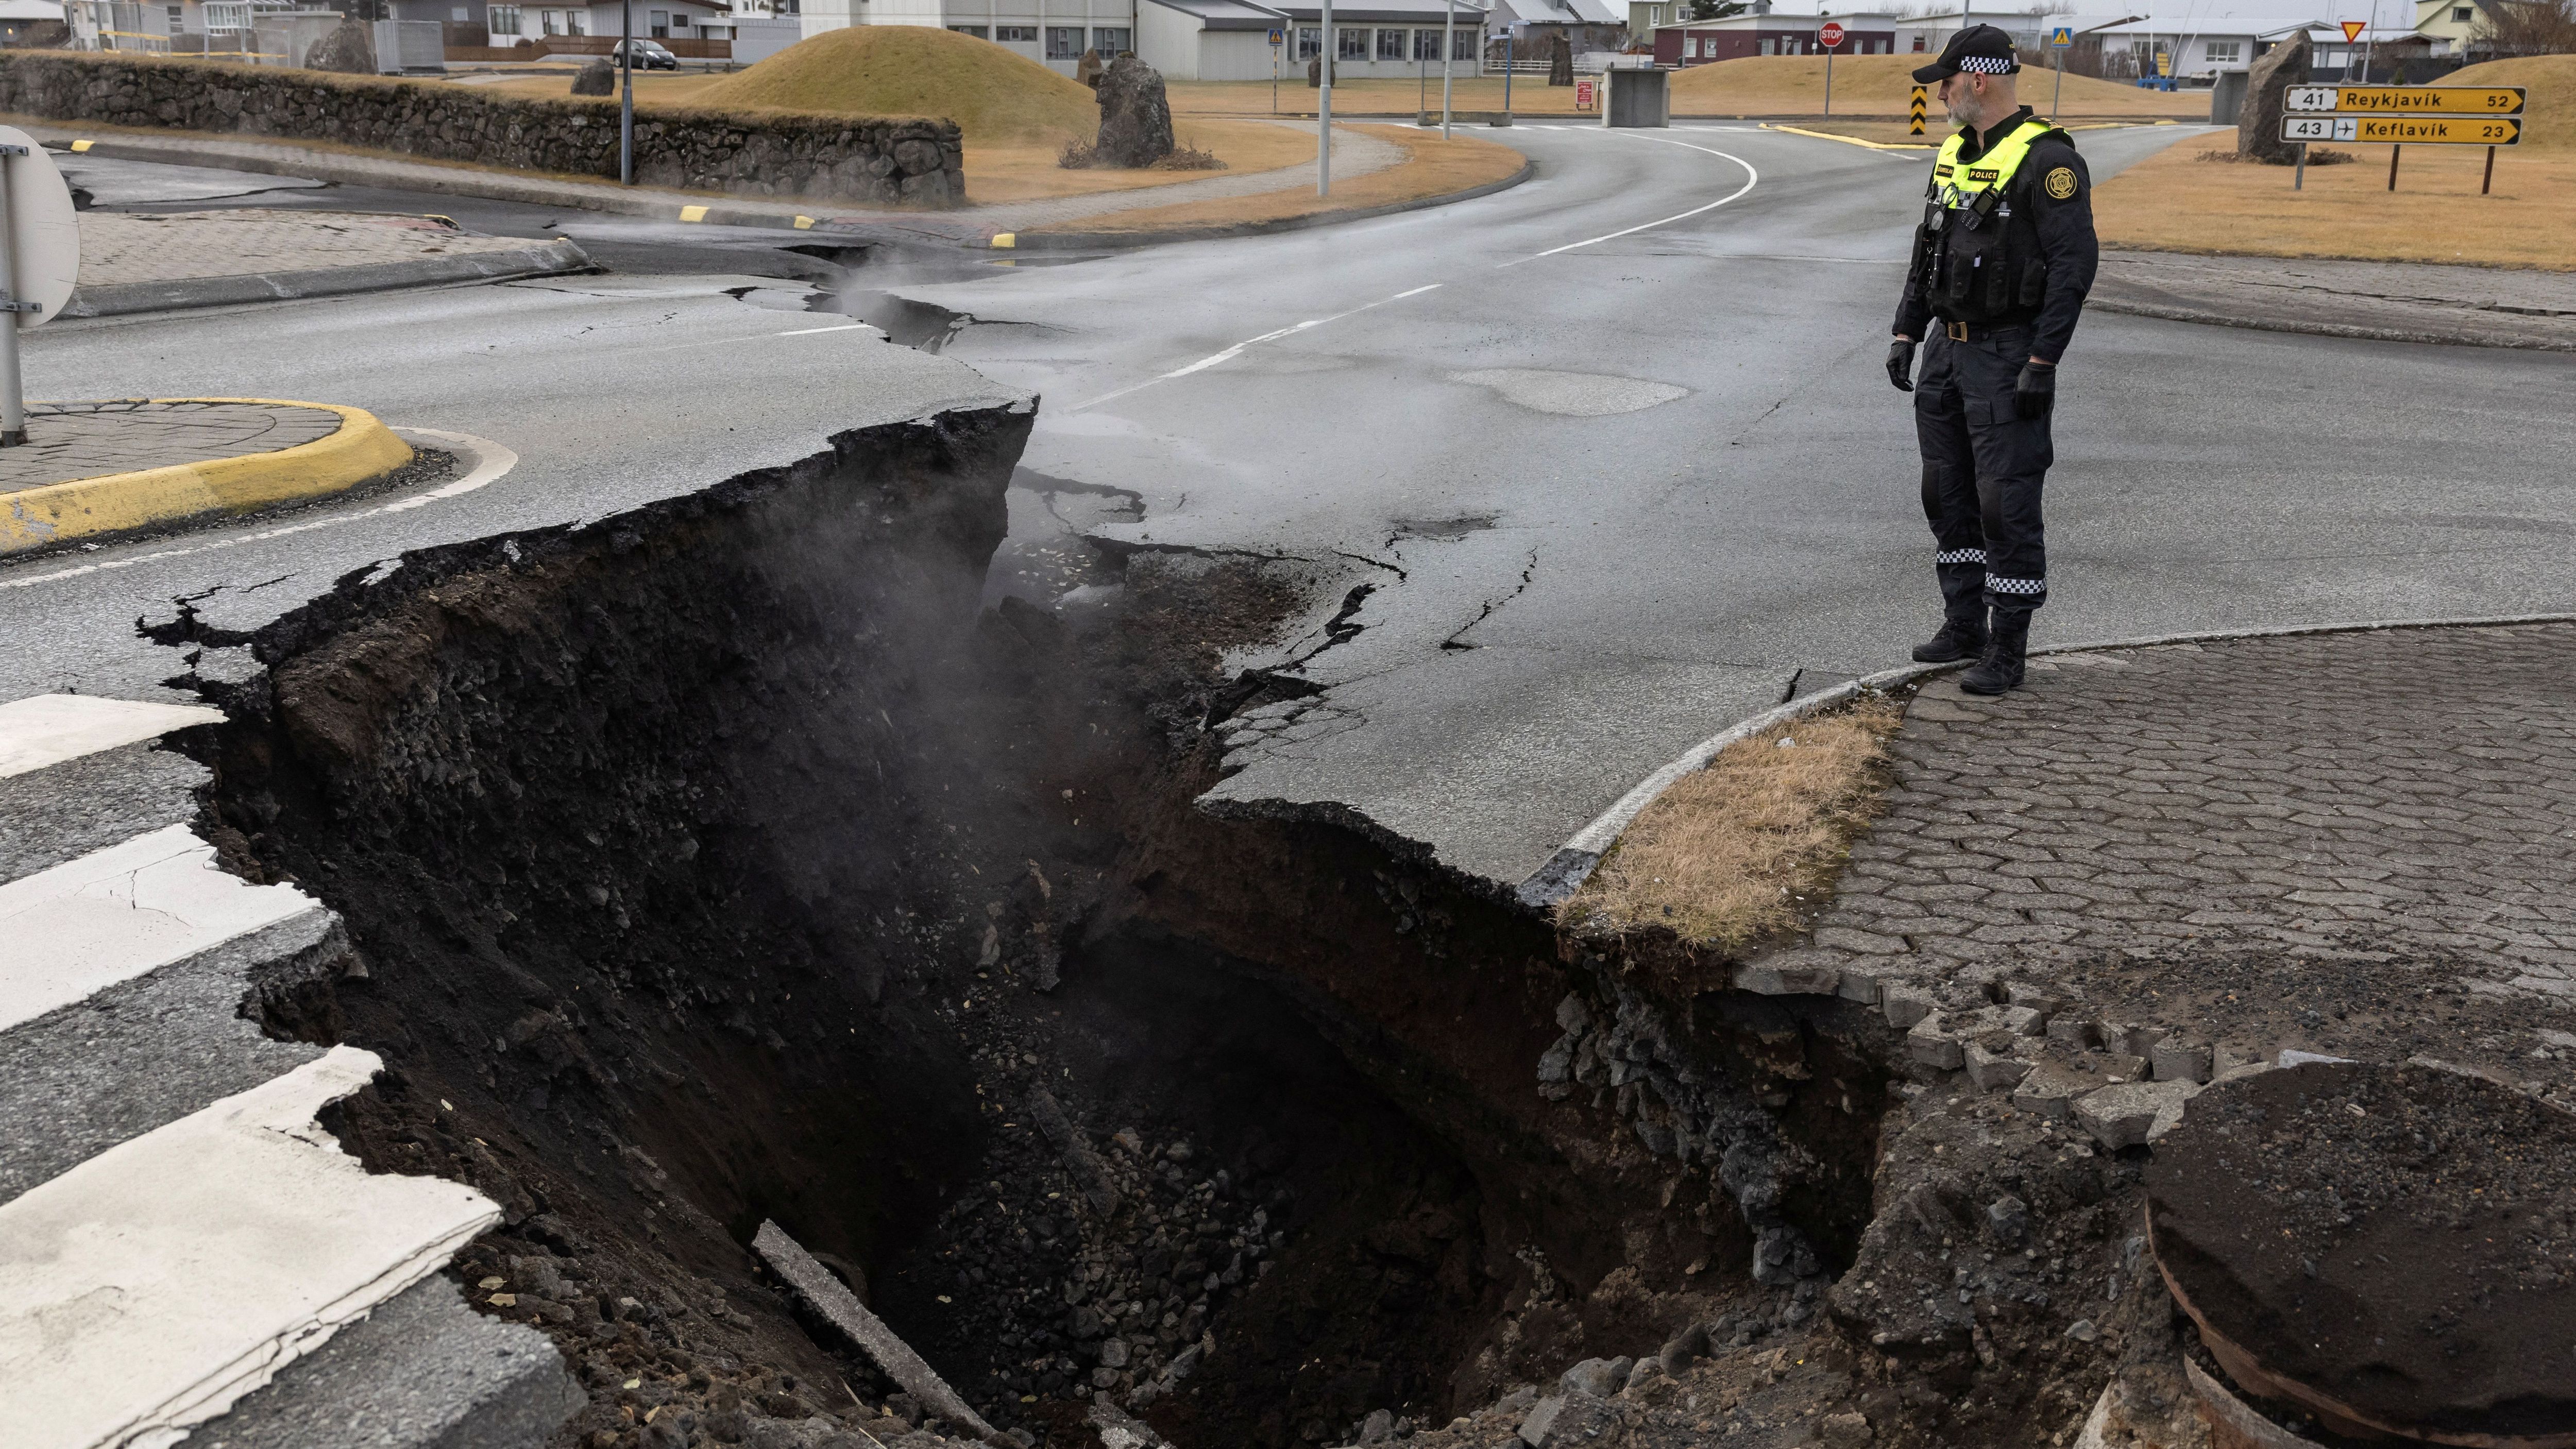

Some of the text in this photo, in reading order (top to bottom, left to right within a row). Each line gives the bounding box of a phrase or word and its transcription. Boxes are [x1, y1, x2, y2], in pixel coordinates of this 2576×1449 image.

[1822, 29, 1842, 39] STOP
[2303, 93, 2509, 108] 41 Reykjavík 52
[2297, 122, 2504, 138] 43 Keflavík 23
